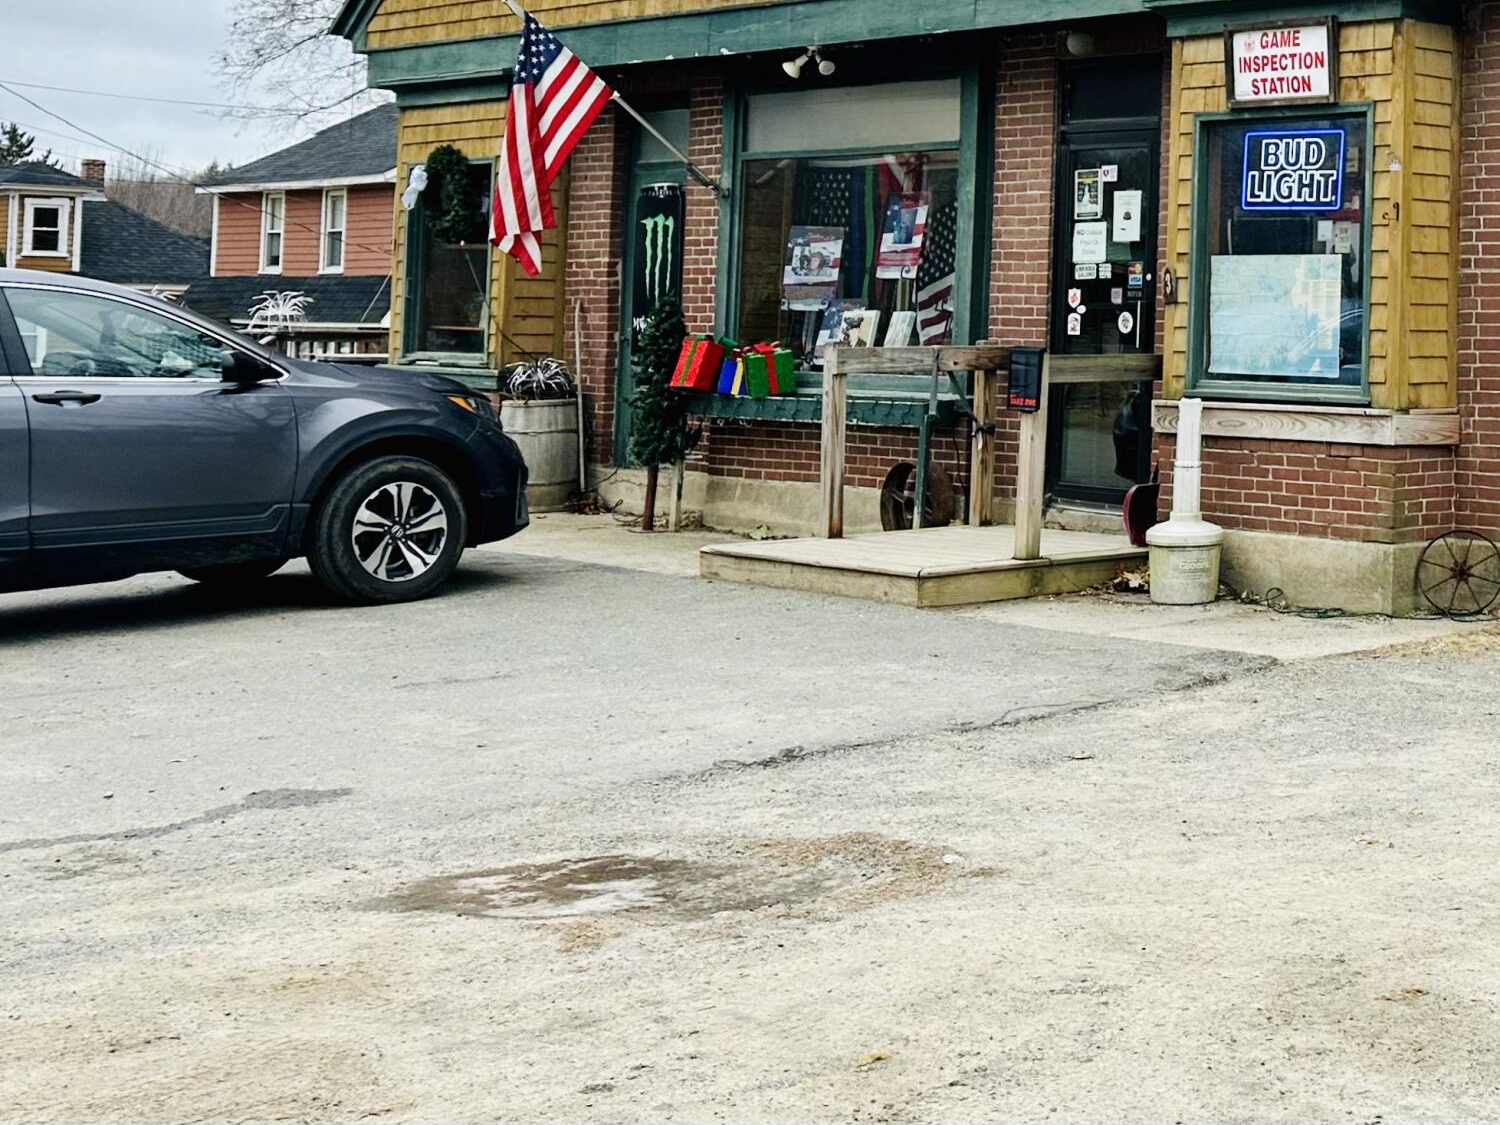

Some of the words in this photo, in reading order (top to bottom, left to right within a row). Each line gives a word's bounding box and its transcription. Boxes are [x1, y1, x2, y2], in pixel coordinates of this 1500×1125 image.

[1260, 29, 1301, 50] GAME
[1239, 51, 1325, 74] INSPECTION
[1251, 75, 1312, 96] STATION
[1261, 138, 1326, 171] BUD
[1247, 170, 1337, 203] LIGHT
[1165, 273, 1172, 295] 3
